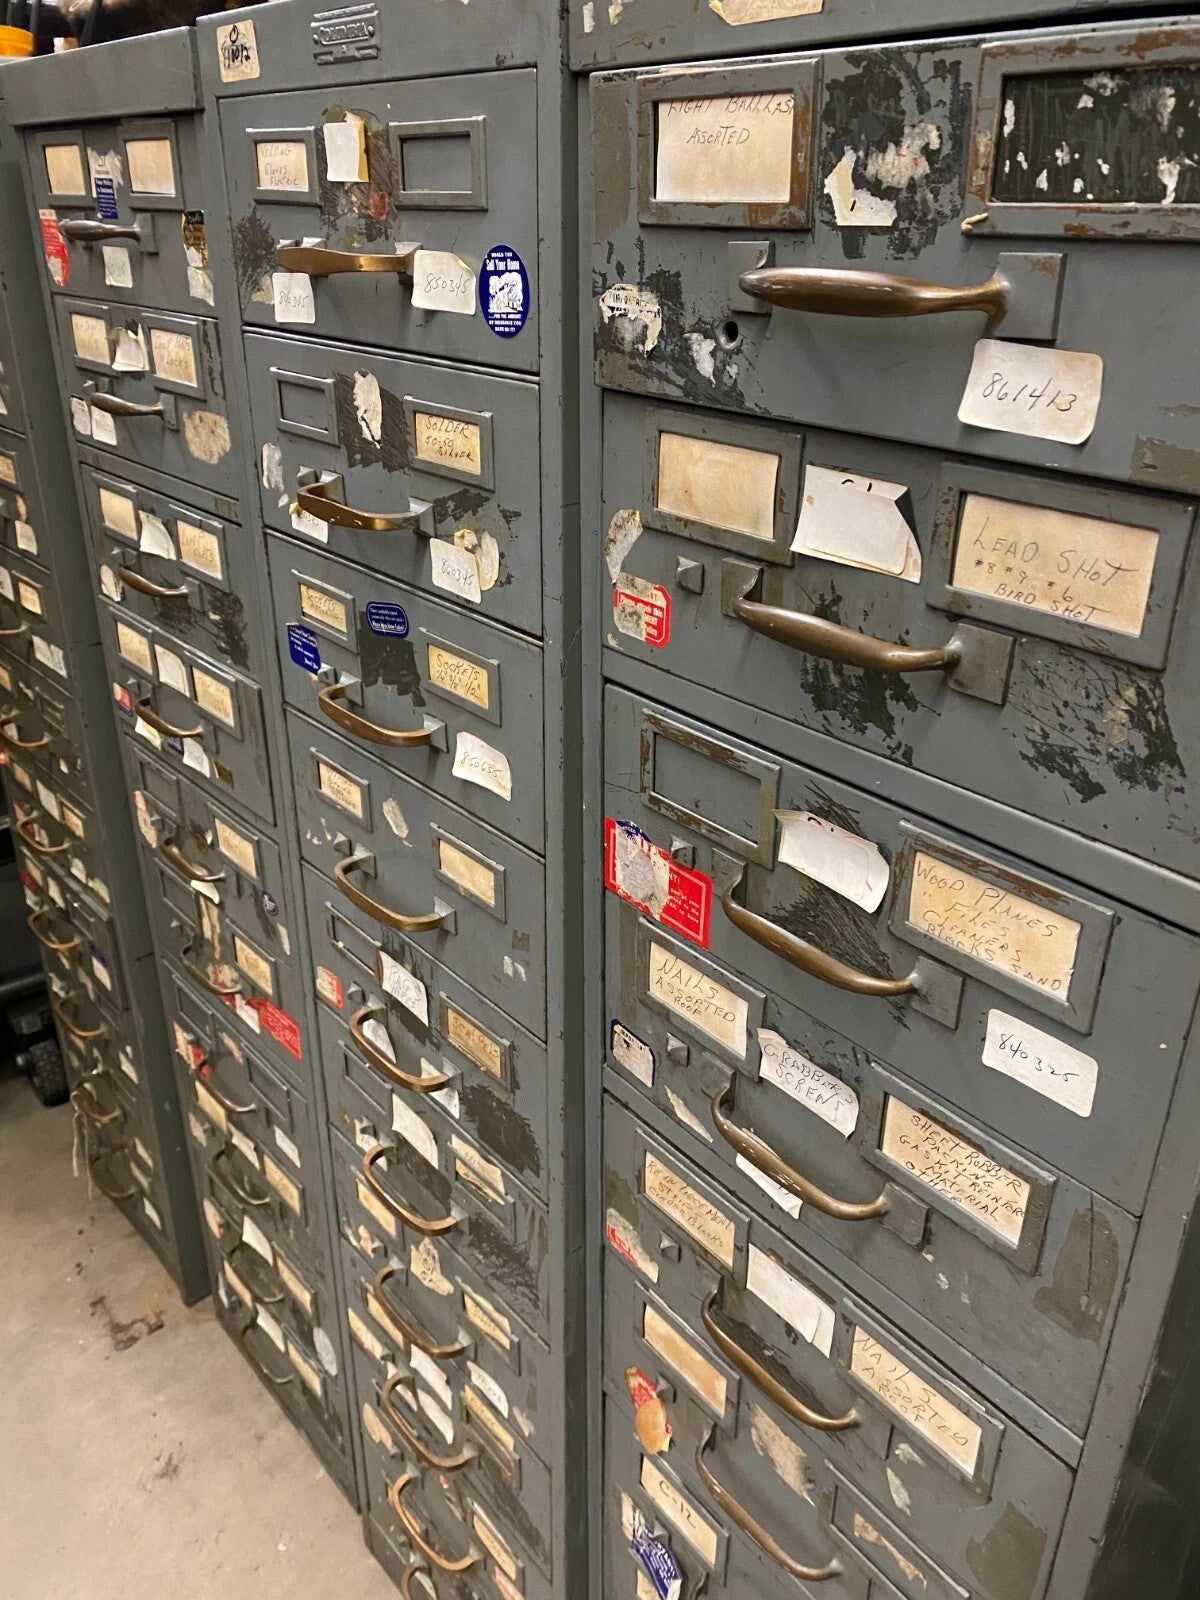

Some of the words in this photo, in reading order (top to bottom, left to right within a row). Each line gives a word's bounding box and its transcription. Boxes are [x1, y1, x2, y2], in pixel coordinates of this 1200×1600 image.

[507, 258, 520, 271] Home
[973, 516, 1039, 563] LEAD
[1057, 549, 1139, 586] SHOT
[995, 583, 1036, 605] BIRD
[1050, 600, 1112, 622] SHOT
[657, 956, 719, 999] NAILS
